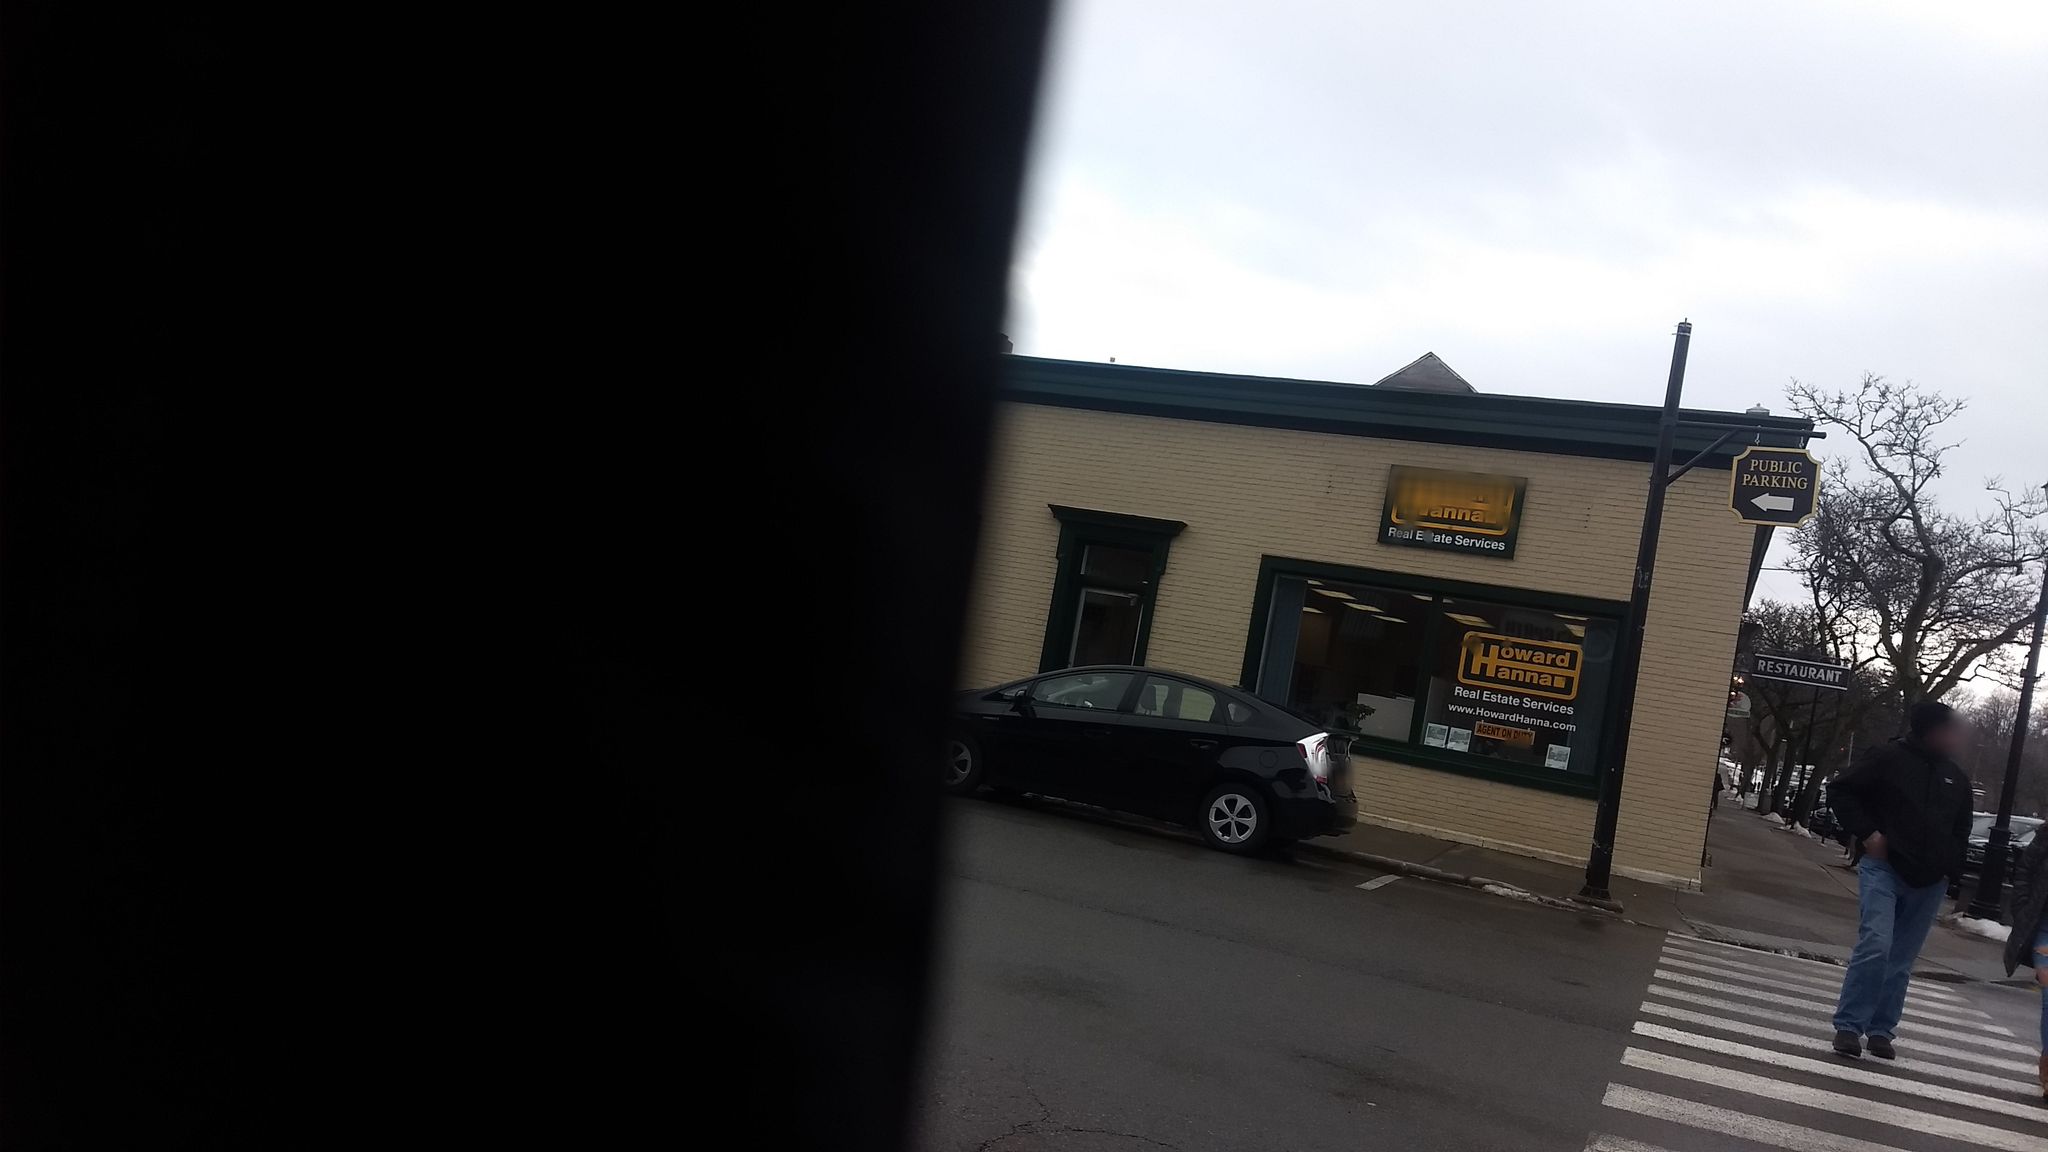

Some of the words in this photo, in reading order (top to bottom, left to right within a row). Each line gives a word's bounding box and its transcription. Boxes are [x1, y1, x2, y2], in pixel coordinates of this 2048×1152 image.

[1750, 459, 1802, 474] PUBLIC
[1742, 473, 1808, 490] PARKING
[1388, 527, 1413, 540] Real
[1415, 530, 1453, 544] Etate
[1455, 535, 1506, 551] Services
[1757, 659, 1843, 683] RESTAURANT
[1454, 685, 1480, 700] Real
[1482, 691, 1520, 707] Estate
[1522, 697, 1575, 716] Services
[1448, 703, 1577, 733] www.HowardHanna.com
[1476, 724, 1501, 737] AGENT
[1501, 728, 1512, 738] ON
